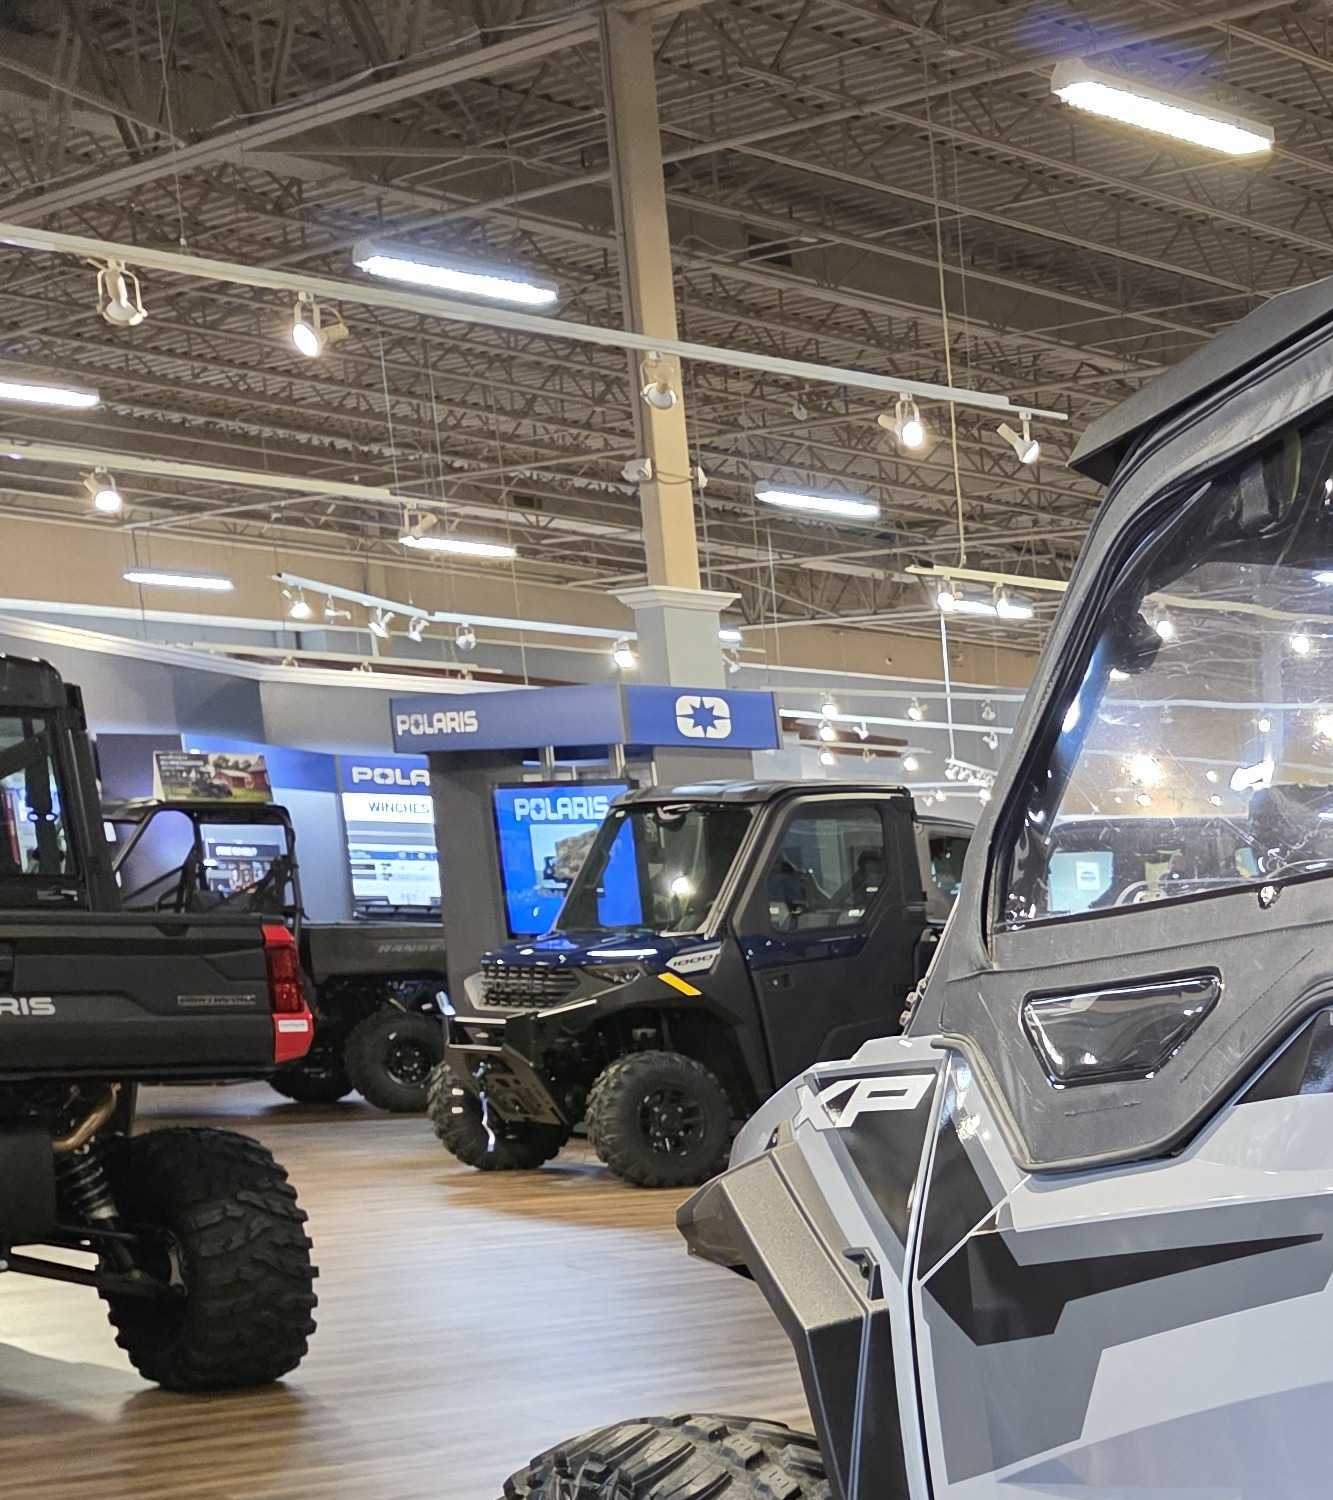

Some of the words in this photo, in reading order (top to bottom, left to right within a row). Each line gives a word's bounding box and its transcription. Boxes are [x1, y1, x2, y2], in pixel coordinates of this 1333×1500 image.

[396, 710, 479, 736] POLARIS
[513, 796, 609, 822] POLARIS
[794, 1073, 937, 1131] XP
